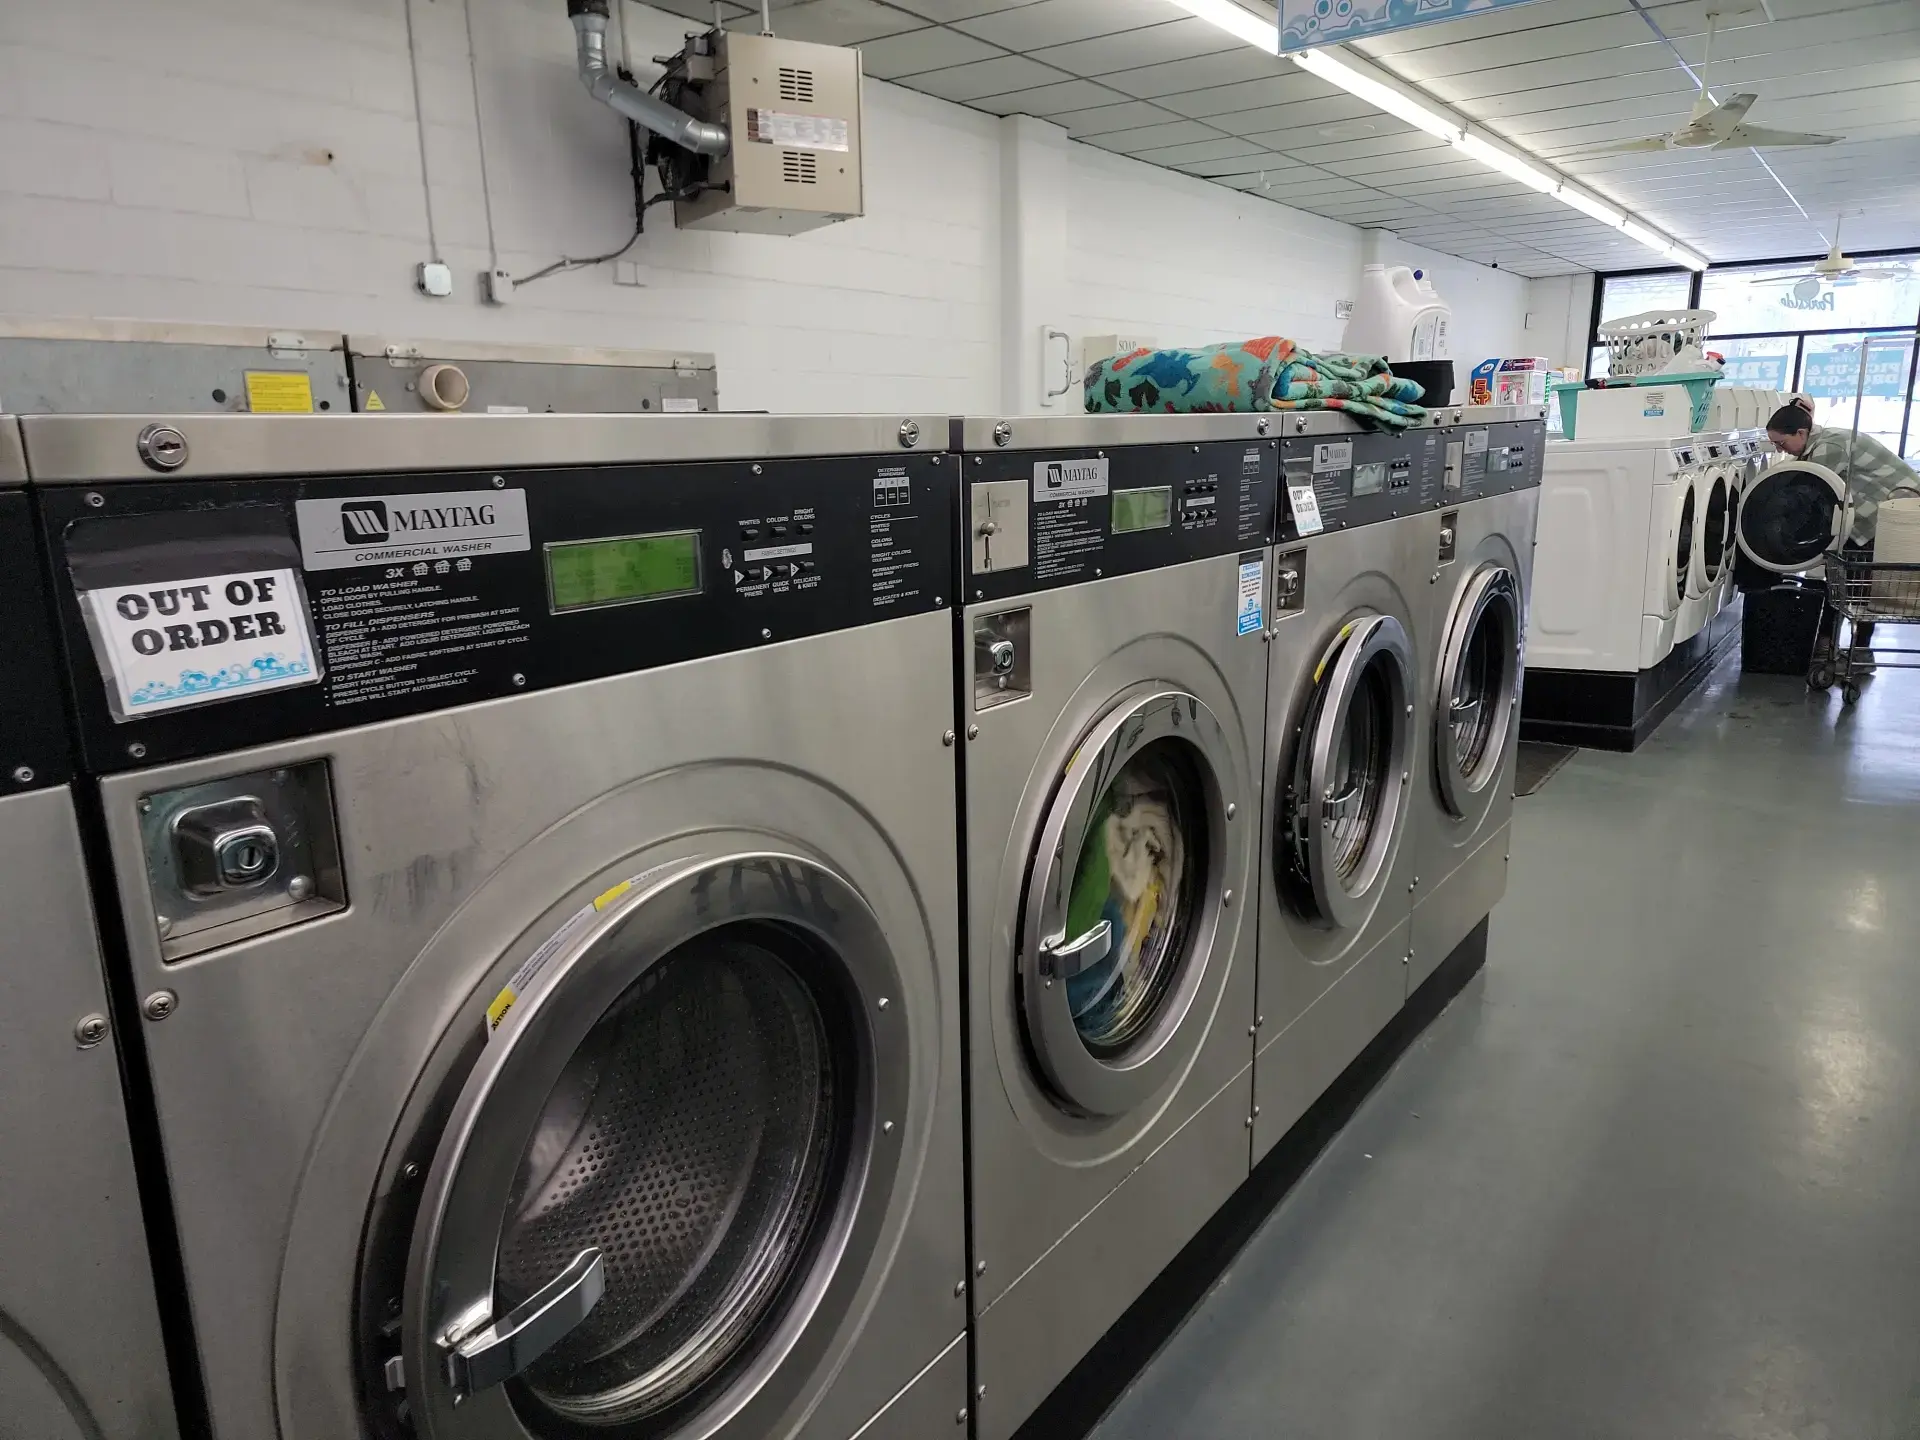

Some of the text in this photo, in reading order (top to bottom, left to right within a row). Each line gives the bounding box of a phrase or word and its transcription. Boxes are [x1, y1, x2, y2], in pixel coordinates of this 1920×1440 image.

[1118, 340, 1136, 352] SOAP
[1064, 467, 1098, 482] MAYTAG
[392, 504, 495, 532] MAYTAG
[355, 542, 492, 561] COMMERCIAL WASHER
[386, 568, 404, 578] 3X
[793, 575, 822, 584] DELICATES
[339, 586, 370, 594] LOAD
[373, 580, 418, 590] WASHER
[736, 582, 770, 592] PERMANENT
[744, 590, 764, 598] PRESS
[116, 576, 276, 621] OUT OF
[322, 604, 344, 612] LOAD
[325, 612, 434, 631] TO FILL DISPENSERS
[132, 611, 286, 656] ORDER
[347, 670, 377, 680] START
[379, 664, 418, 674] WASHER
